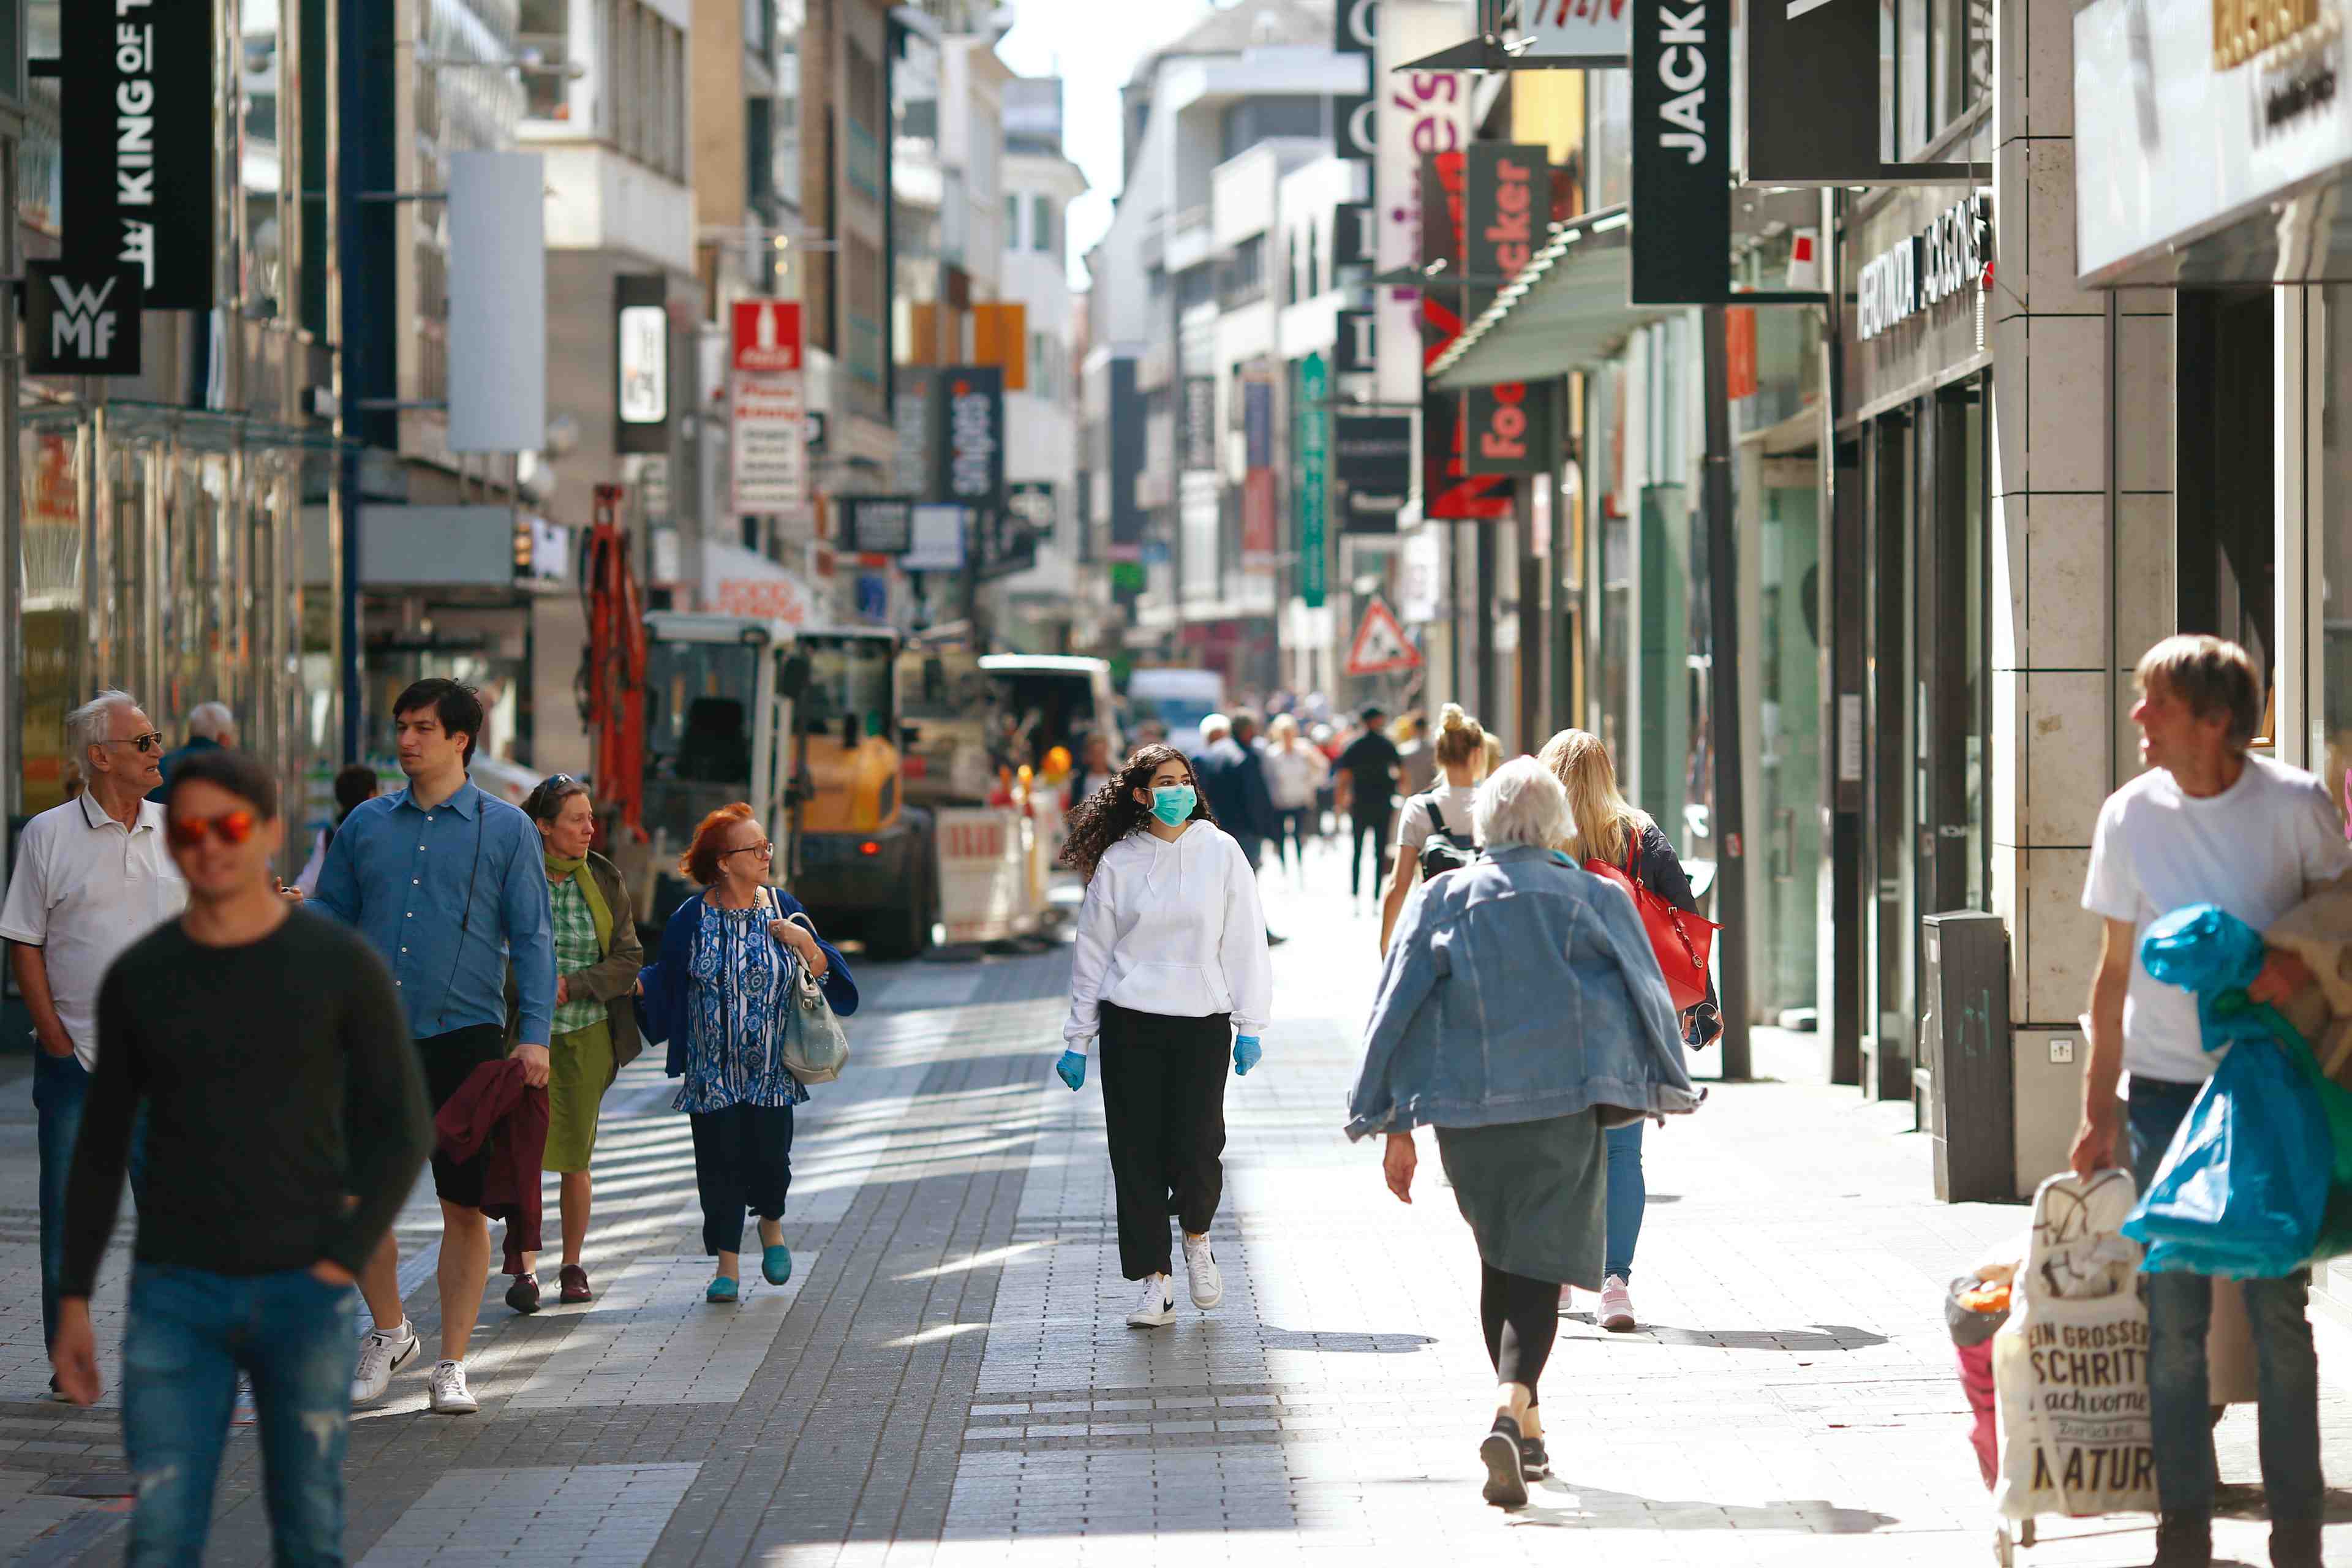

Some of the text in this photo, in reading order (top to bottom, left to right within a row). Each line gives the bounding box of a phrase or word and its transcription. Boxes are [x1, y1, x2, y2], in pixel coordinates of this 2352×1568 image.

[116, 23, 145, 74] OF
[1659, 5, 1707, 164] JACK
[116, 80, 154, 205] KING
[1481, 157, 1530, 458] Foo cker
[2030, 1348, 2147, 1386] SCHRIT
[2030, 1389, 2086, 1413] ach
